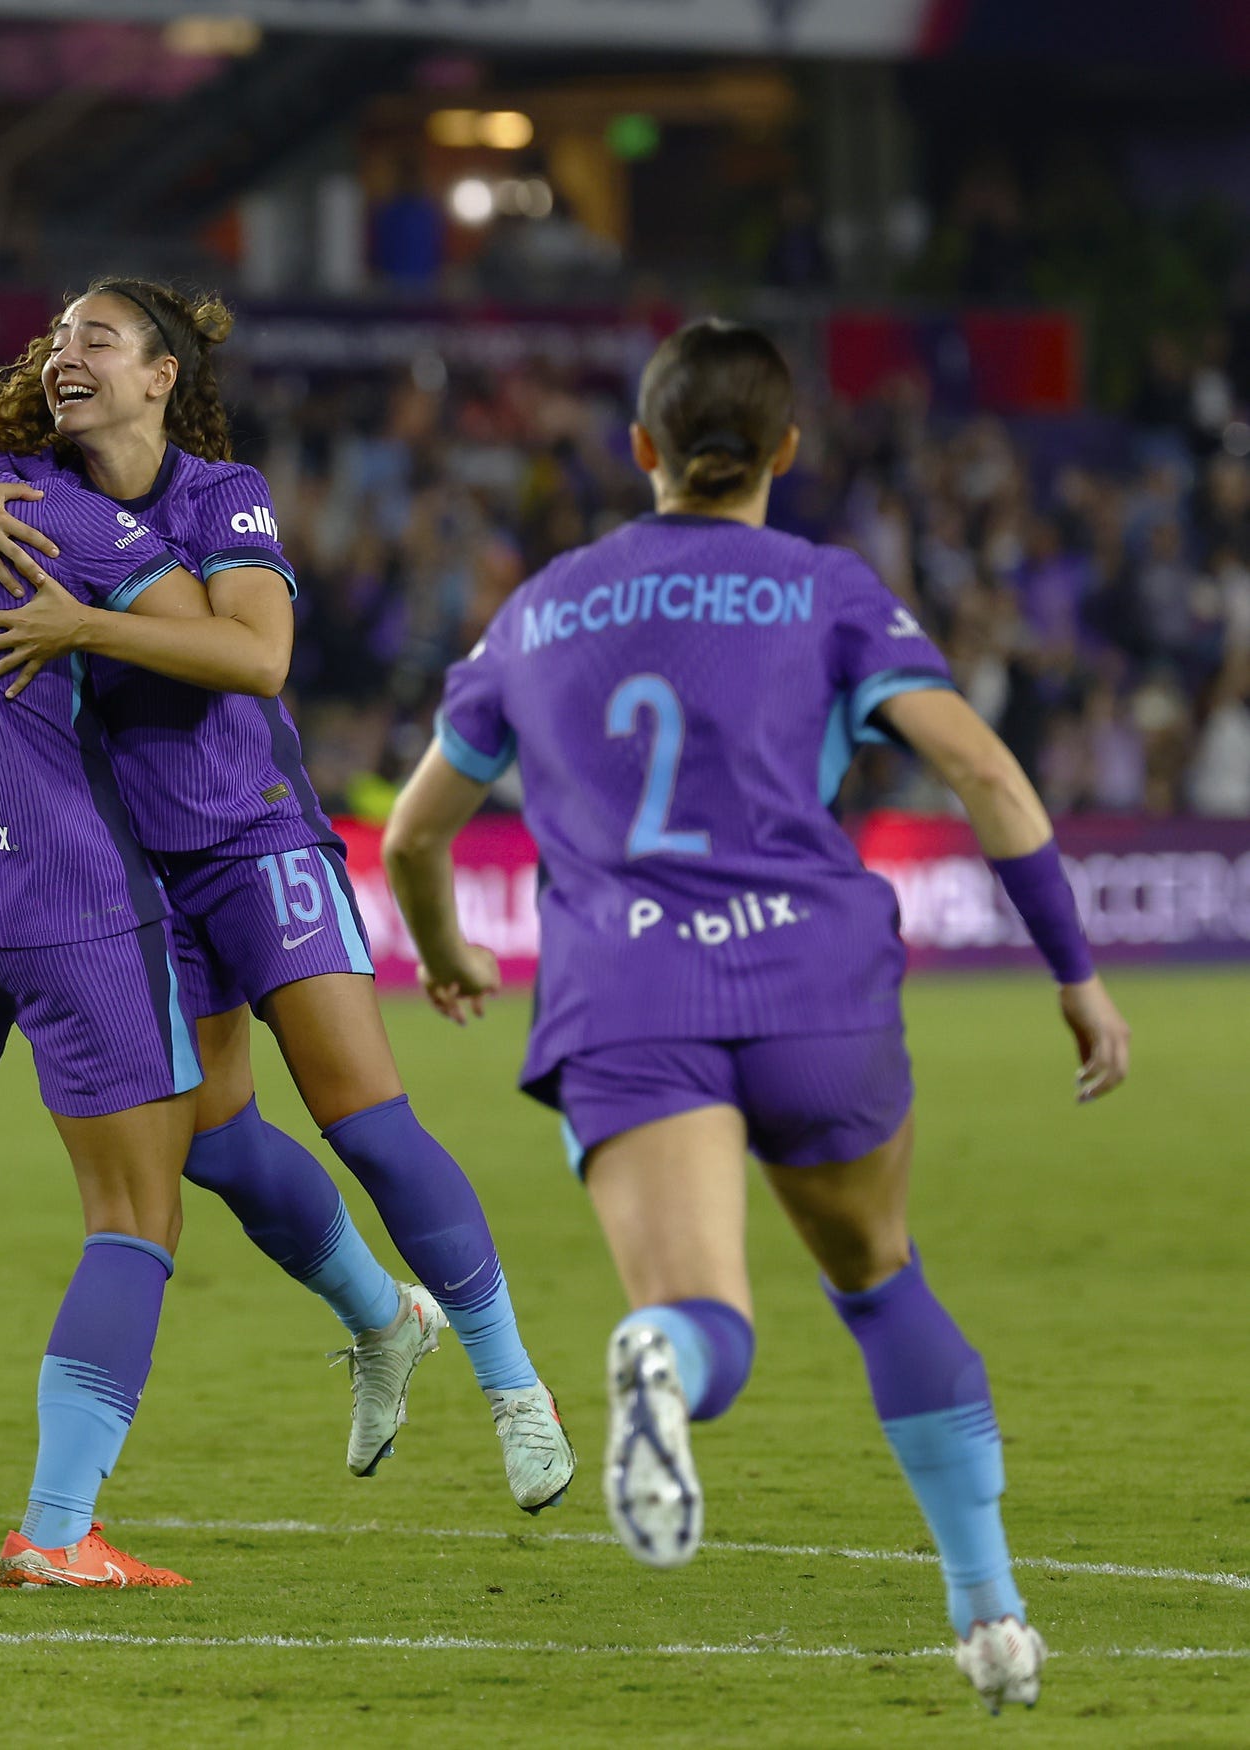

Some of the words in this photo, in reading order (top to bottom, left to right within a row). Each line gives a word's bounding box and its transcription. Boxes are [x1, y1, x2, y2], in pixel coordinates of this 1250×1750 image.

[522, 573, 814, 653] McCUTCHEON
[607, 672, 713, 864] 2
[257, 848, 323, 927] 15
